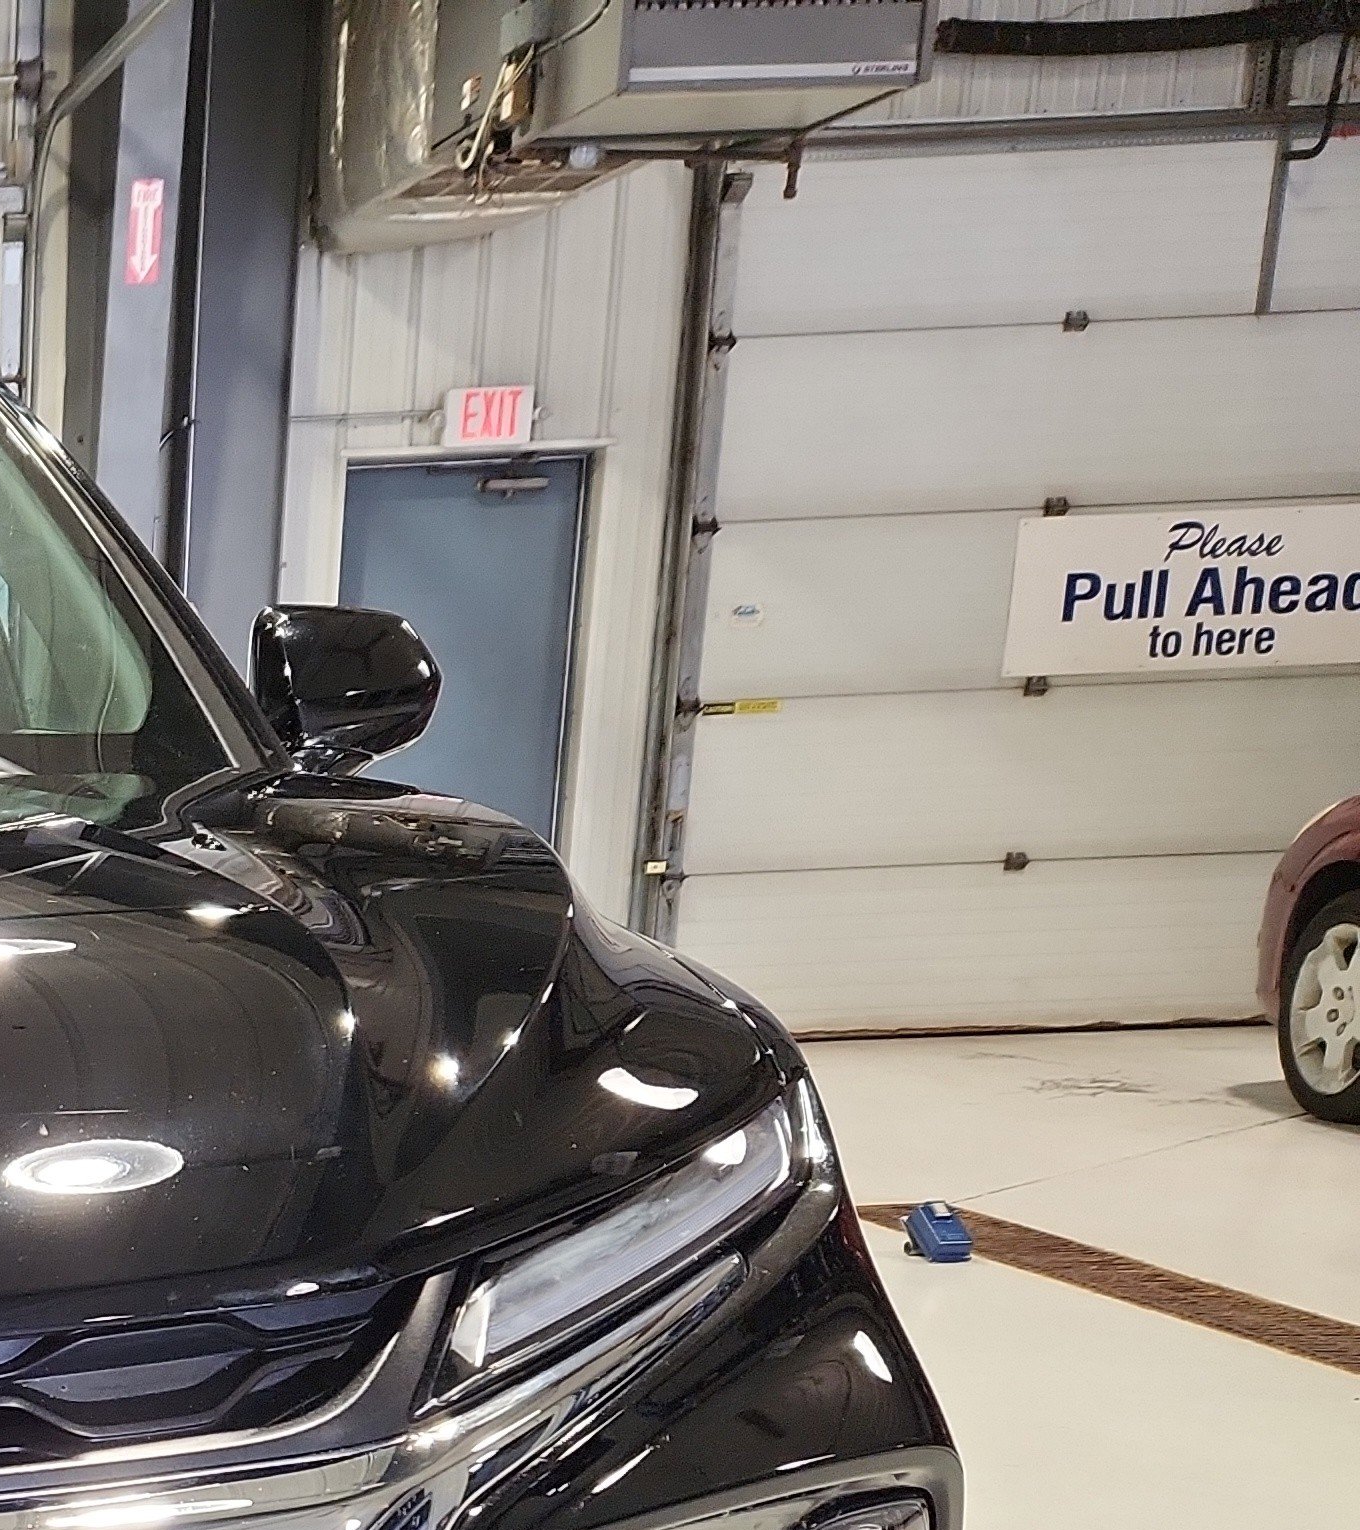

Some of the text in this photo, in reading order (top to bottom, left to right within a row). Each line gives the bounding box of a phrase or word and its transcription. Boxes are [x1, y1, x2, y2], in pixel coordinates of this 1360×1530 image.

[461, 388, 522, 438] EXIT
[1163, 521, 1284, 562] Please
[1061, 568, 1170, 622] Pull
[1148, 621, 1276, 658] to here
